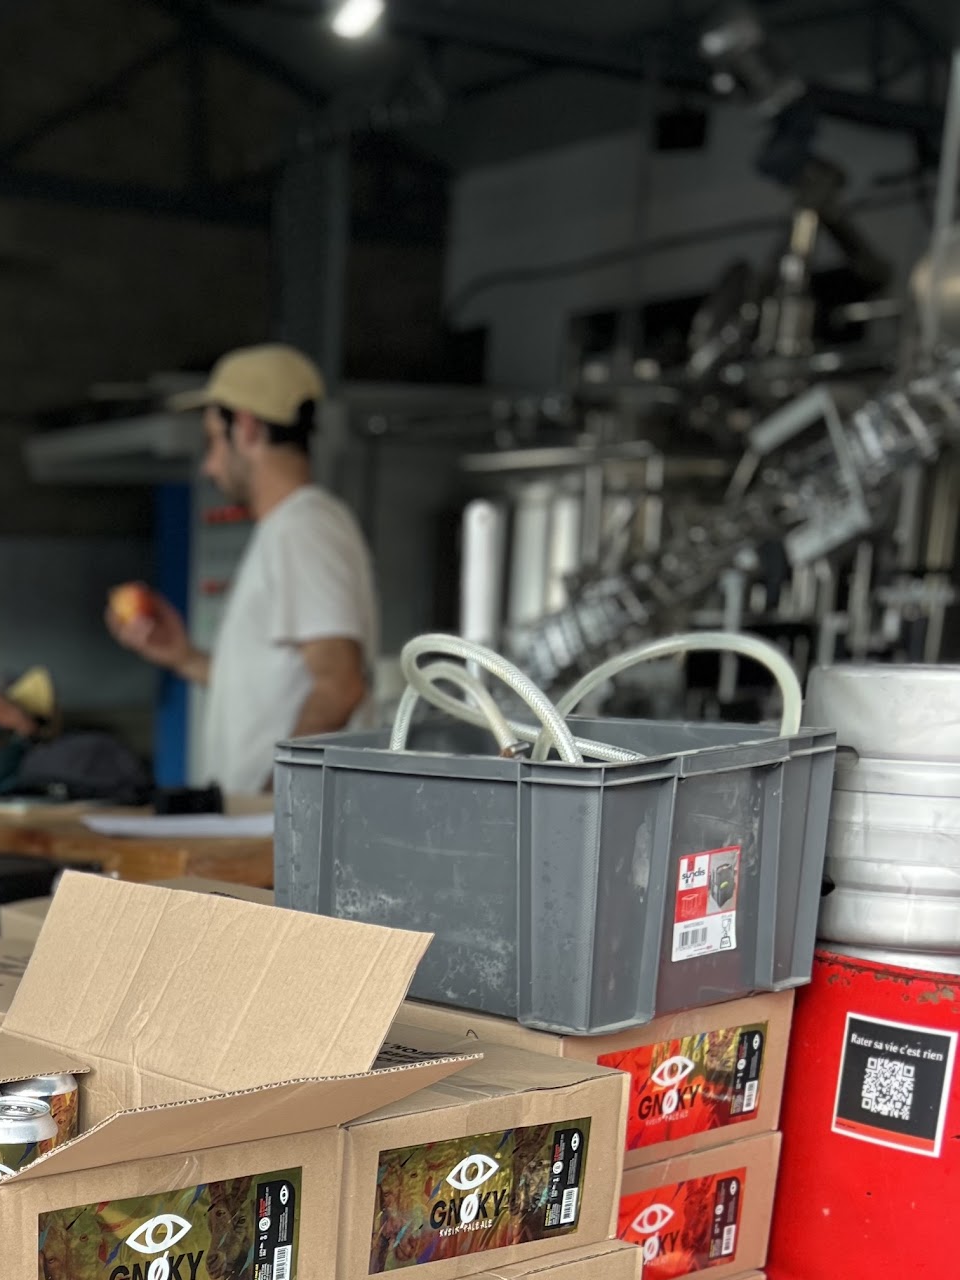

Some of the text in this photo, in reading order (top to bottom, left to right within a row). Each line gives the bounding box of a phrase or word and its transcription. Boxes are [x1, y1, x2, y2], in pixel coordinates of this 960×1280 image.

[851, 1033, 944, 1061] Rater sa vie c'est rien
